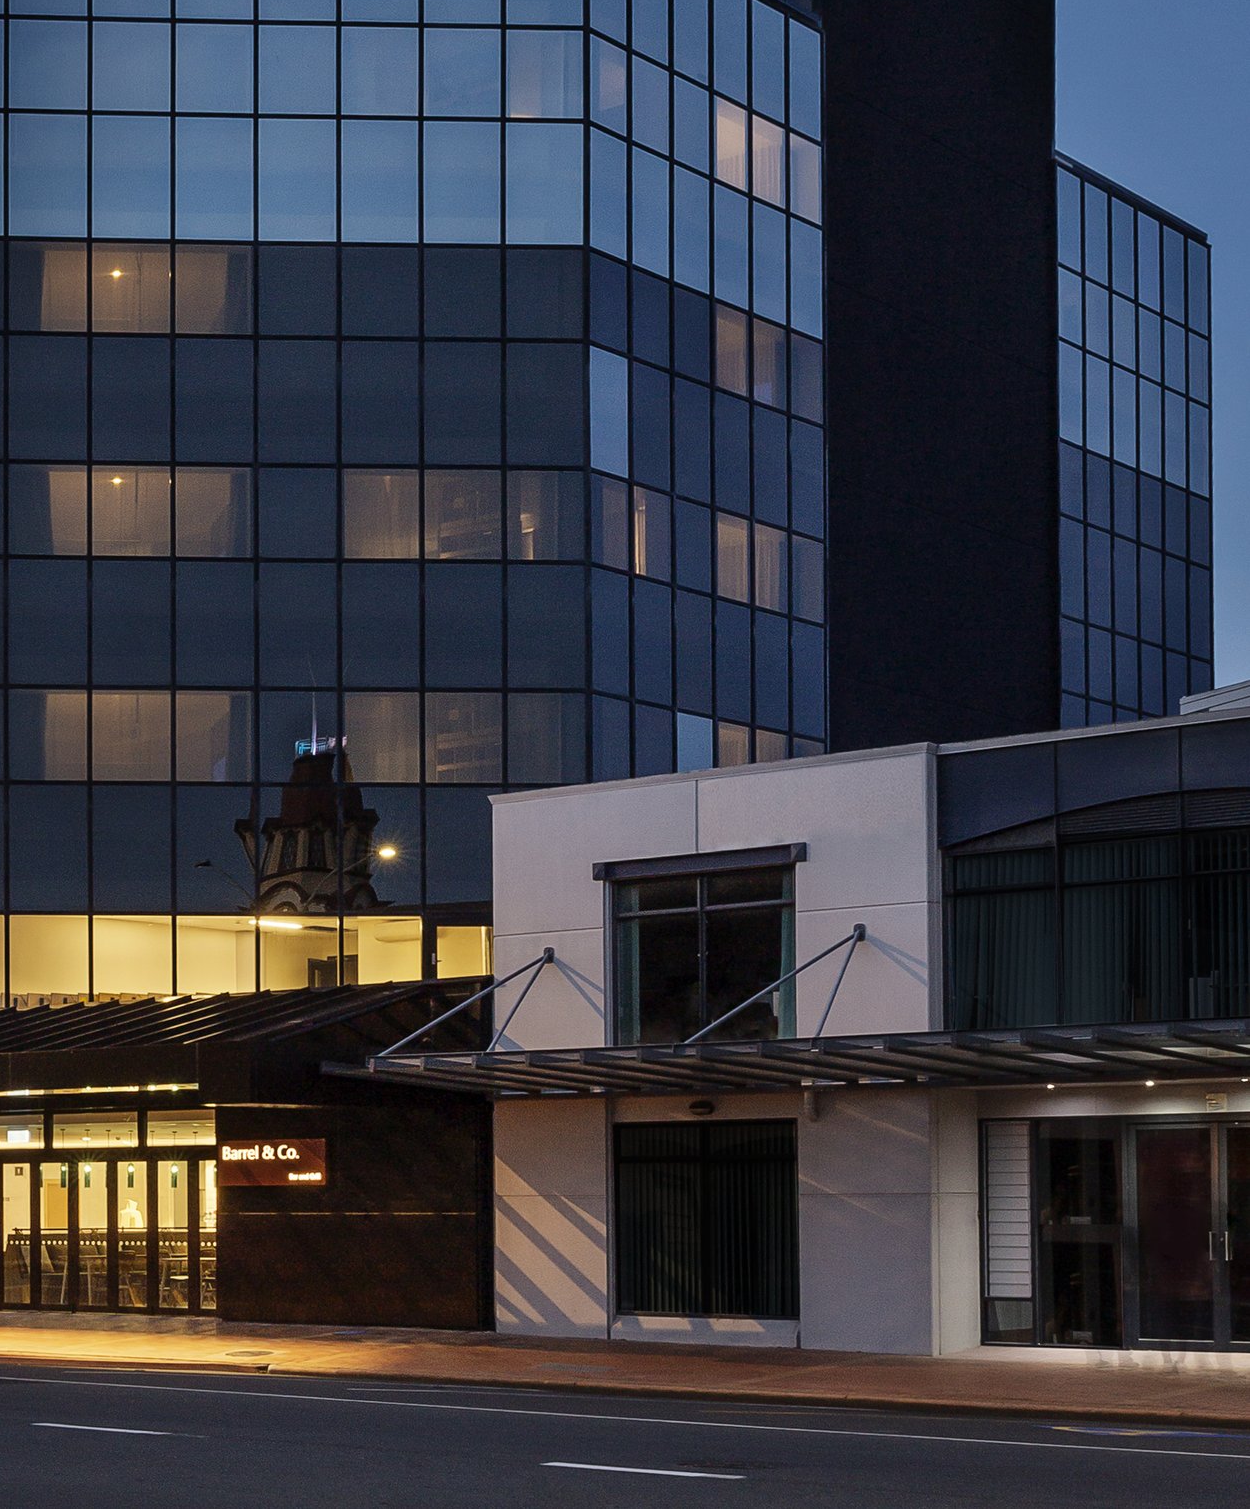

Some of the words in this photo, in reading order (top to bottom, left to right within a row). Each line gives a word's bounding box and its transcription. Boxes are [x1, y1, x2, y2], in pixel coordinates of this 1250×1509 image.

[222, 1145, 259, 1160] Barrel
[262, 1144, 275, 1160] &
[277, 1144, 300, 1160] Co.
